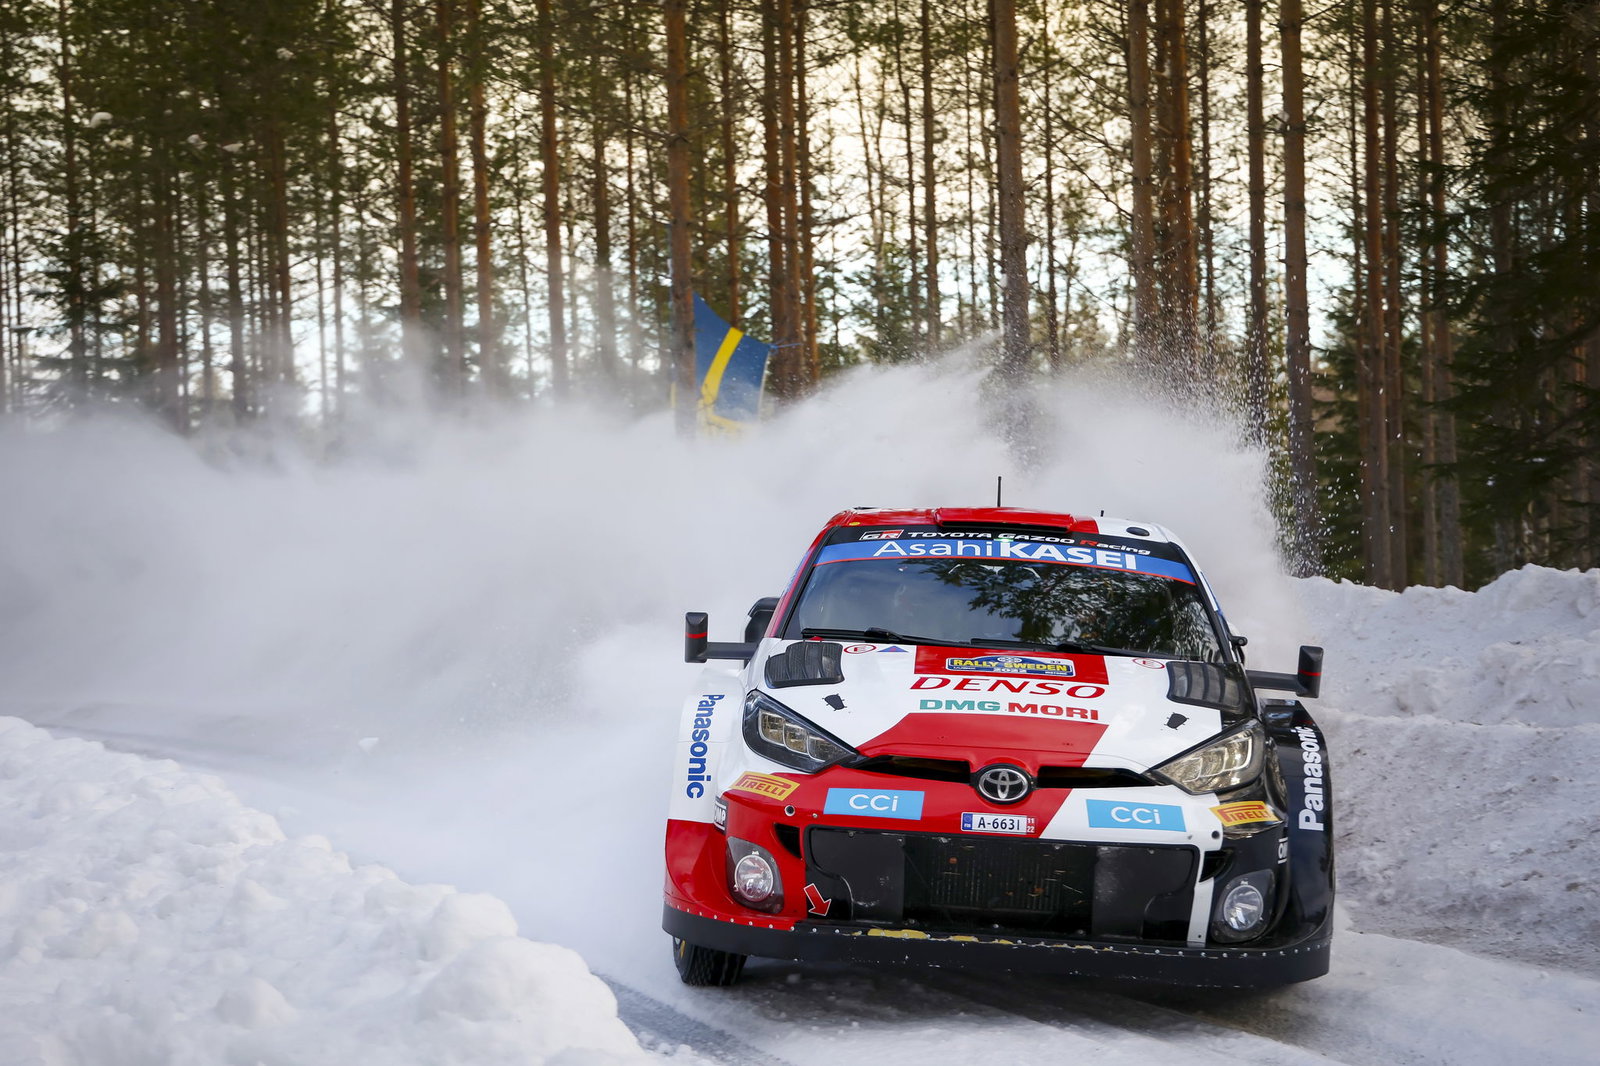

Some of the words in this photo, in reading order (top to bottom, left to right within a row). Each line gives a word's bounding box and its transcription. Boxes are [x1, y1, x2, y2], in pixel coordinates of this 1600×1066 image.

[863, 531, 899, 540] GR
[998, 533, 1075, 544] GAZOO
[1079, 539, 1151, 556] Racing
[953, 659, 999, 668] RALLY
[1004, 662, 1067, 672] SWEDEN
[910, 676, 1105, 699] DENSO
[919, 699, 1000, 711] DMG
[1008, 702, 1099, 721] MORI
[686, 694, 725, 798] Panasonic
[737, 774, 792, 797] PIRELLI
[1290, 726, 1324, 831] Panasonic
[1217, 804, 1272, 823] PIRELLI
